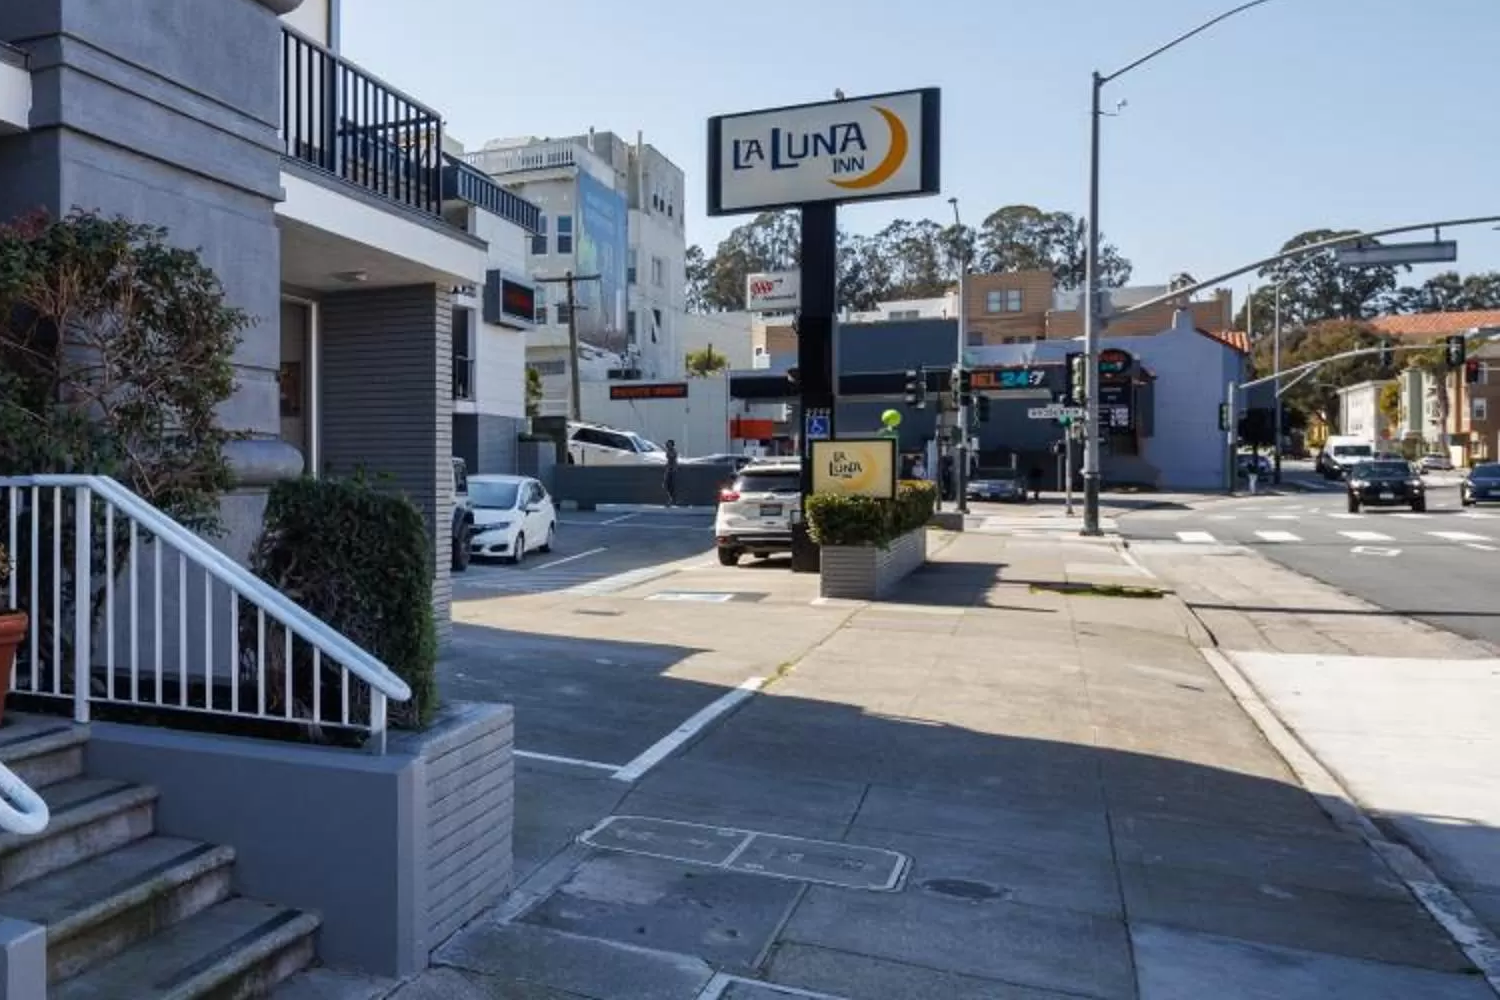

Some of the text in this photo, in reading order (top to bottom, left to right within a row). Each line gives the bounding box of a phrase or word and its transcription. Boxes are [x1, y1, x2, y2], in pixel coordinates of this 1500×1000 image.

[733, 122, 867, 170] LA LUNA
[833, 156, 865, 174] INN
